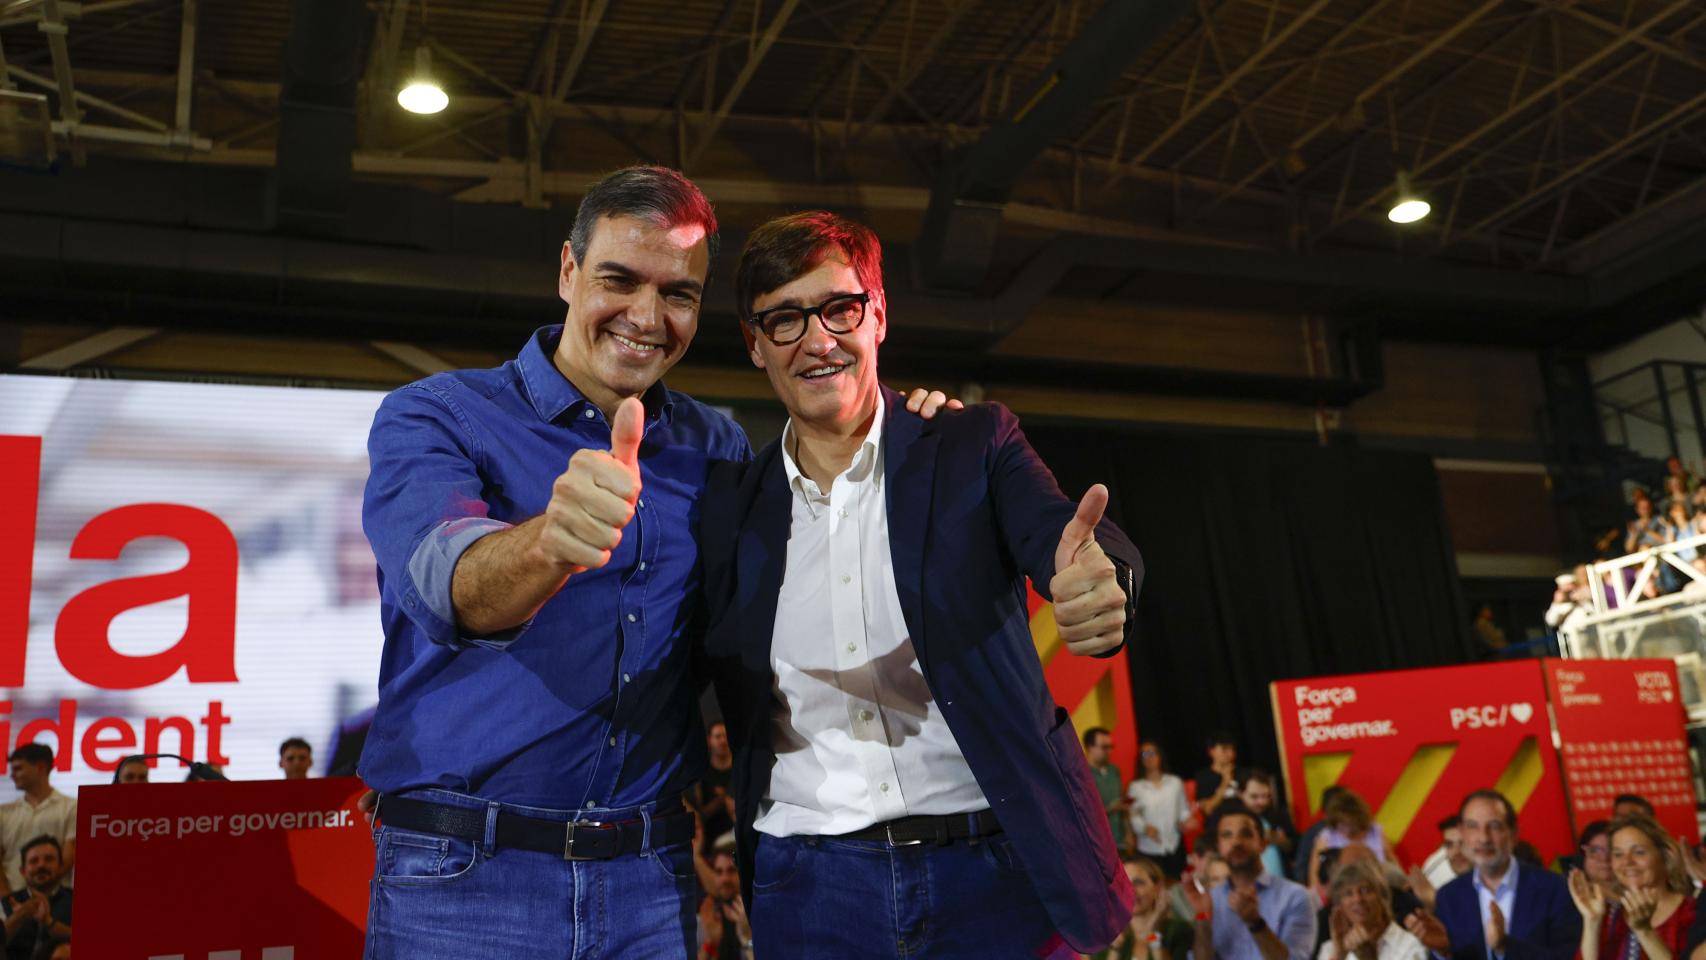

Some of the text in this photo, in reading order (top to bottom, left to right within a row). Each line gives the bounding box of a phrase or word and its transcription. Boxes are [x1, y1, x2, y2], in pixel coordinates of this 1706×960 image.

[1295, 686, 1357, 708] Força
[1298, 707, 1332, 727] per
[1301, 720, 1398, 746] governar.
[90, 808, 354, 841] Força per governar.
